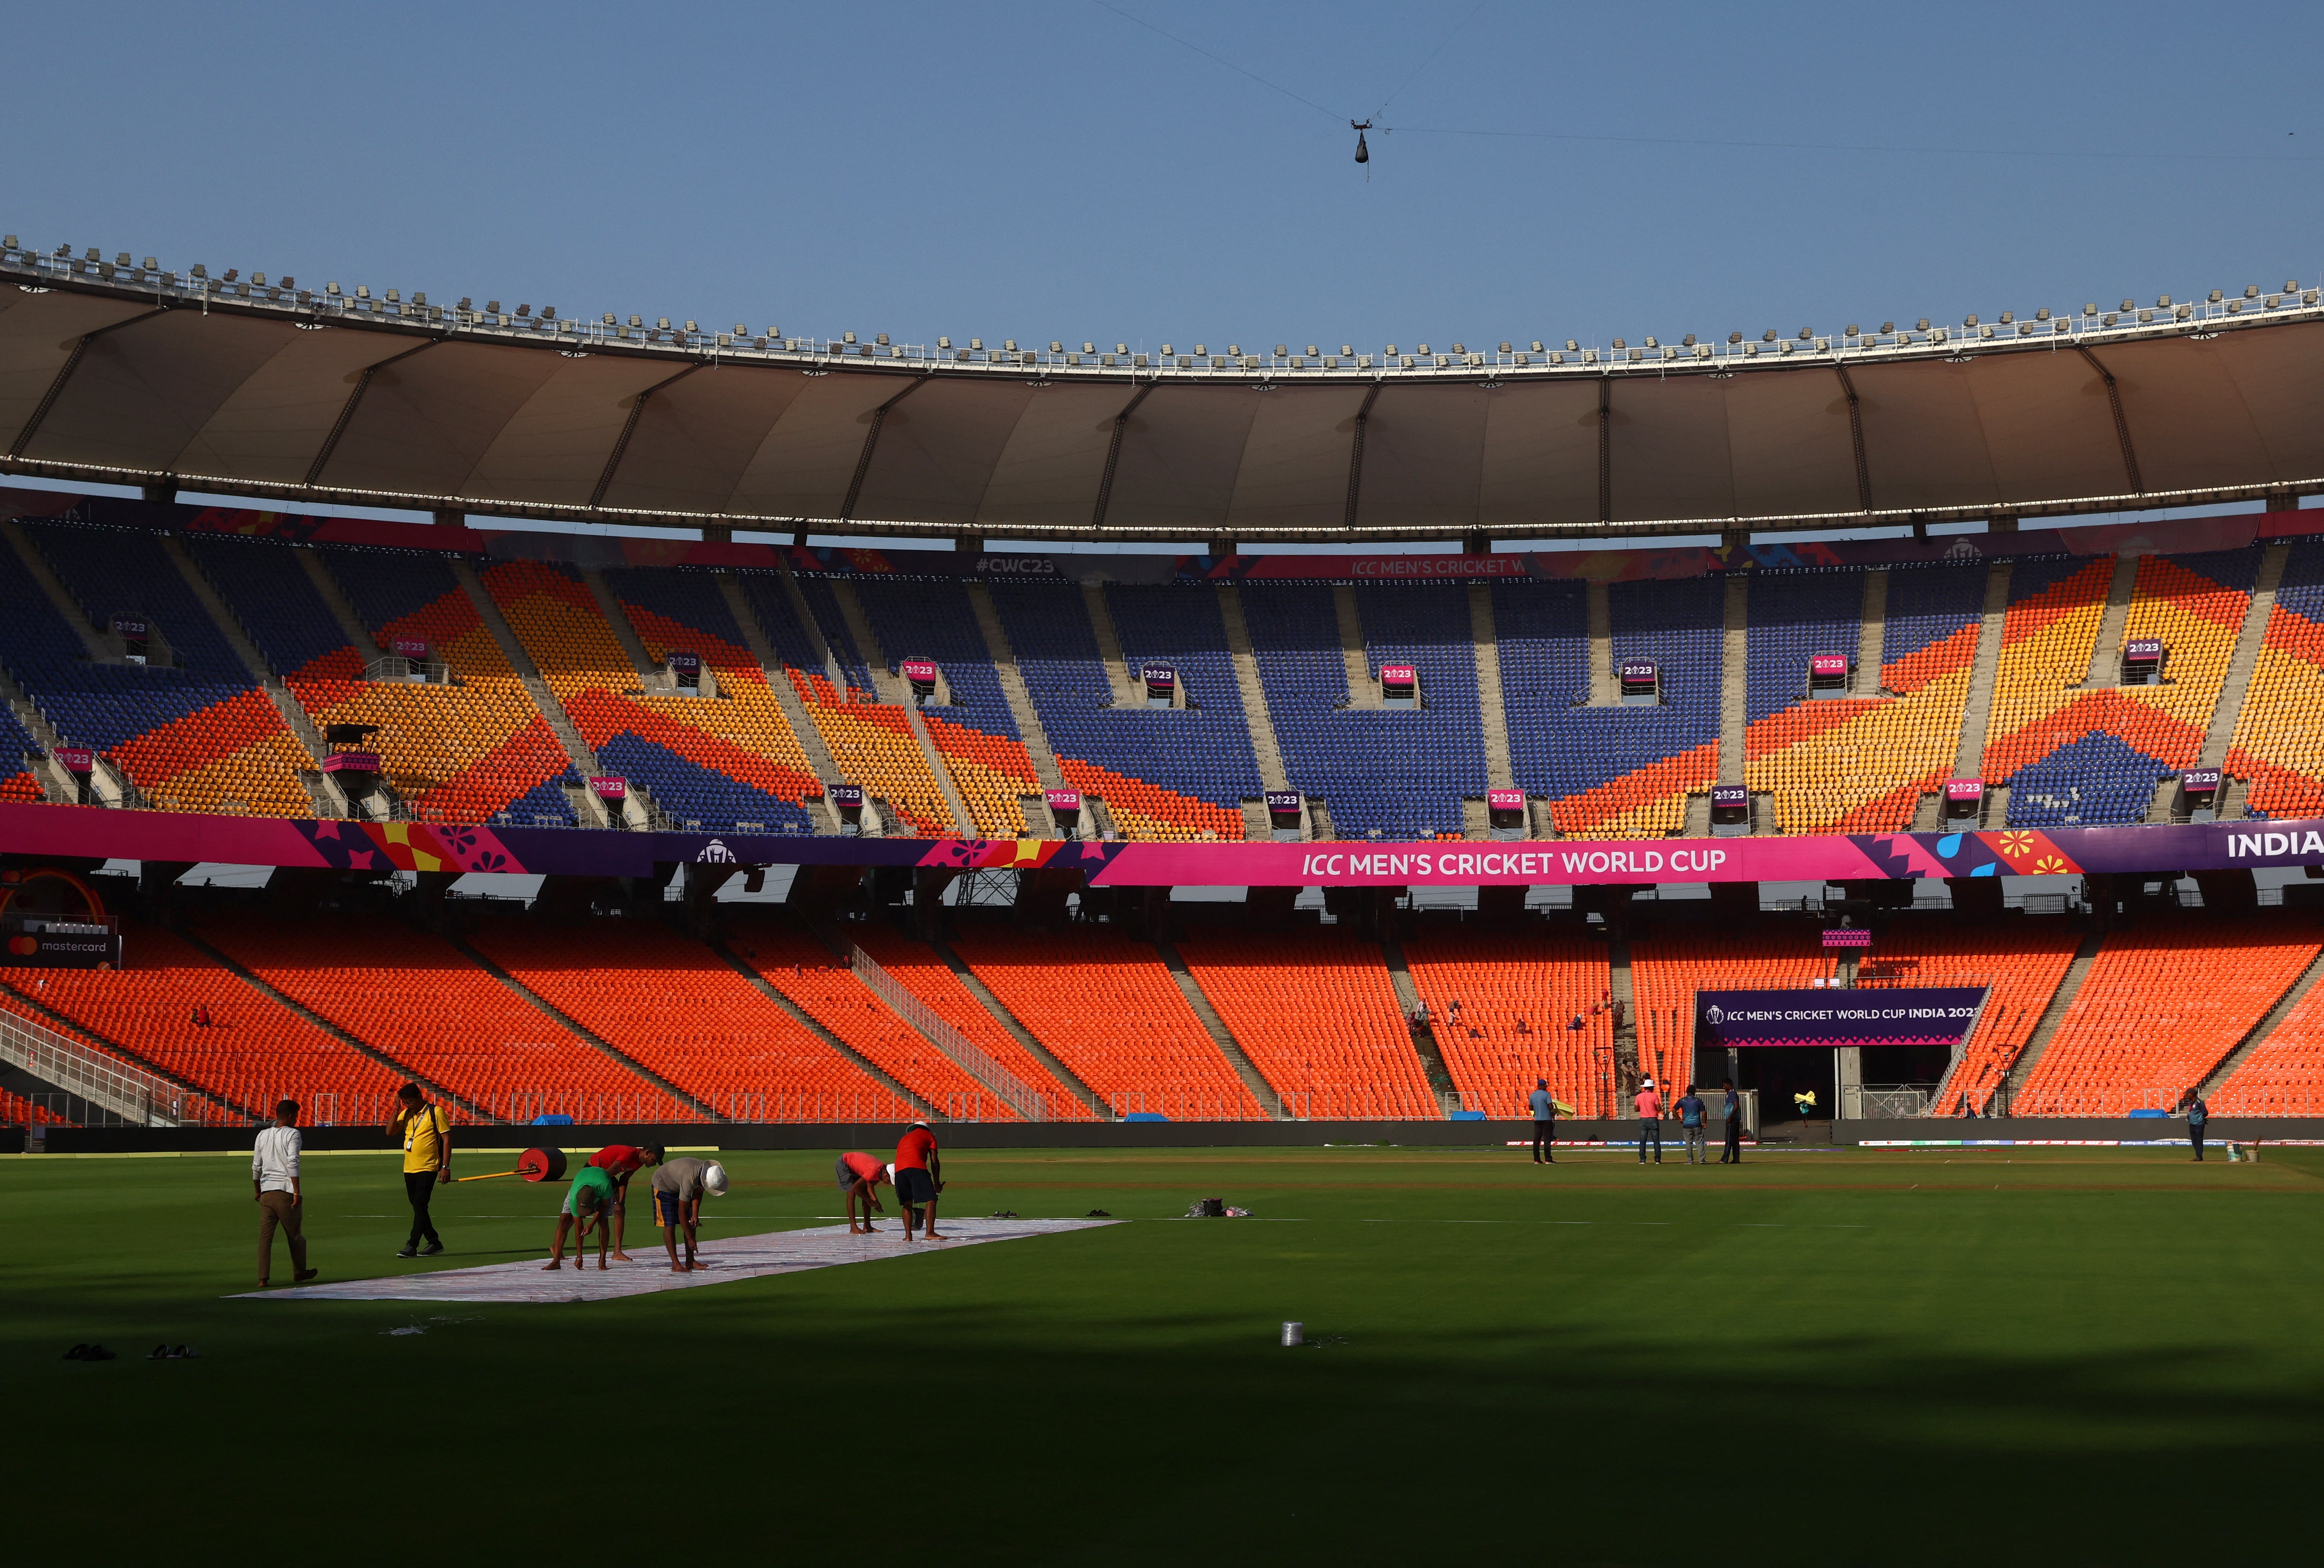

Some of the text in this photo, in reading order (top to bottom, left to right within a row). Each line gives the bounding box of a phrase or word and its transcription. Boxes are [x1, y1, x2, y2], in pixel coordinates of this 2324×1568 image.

[976, 558, 1055, 573] #CWC23
[1352, 561, 1377, 575] ICC
[1381, 561, 1432, 574] MEN'S
[1436, 560, 1507, 574] CRICKET
[2228, 831, 2324, 857] INDIA
[1302, 849, 1726, 876] ICC MEN'S CRICKET WORLD CUP
[42, 942, 106, 952] mastercard
[1727, 1011, 1745, 1021] ICC
[1747, 1010, 1782, 1021] MEN'S
[1785, 1010, 1833, 1020] CRICKET
[1836, 1010, 1880, 1019] WORLD
[1882, 1009, 1906, 1019] CUP
[1909, 1008, 1946, 1018] INDIA
